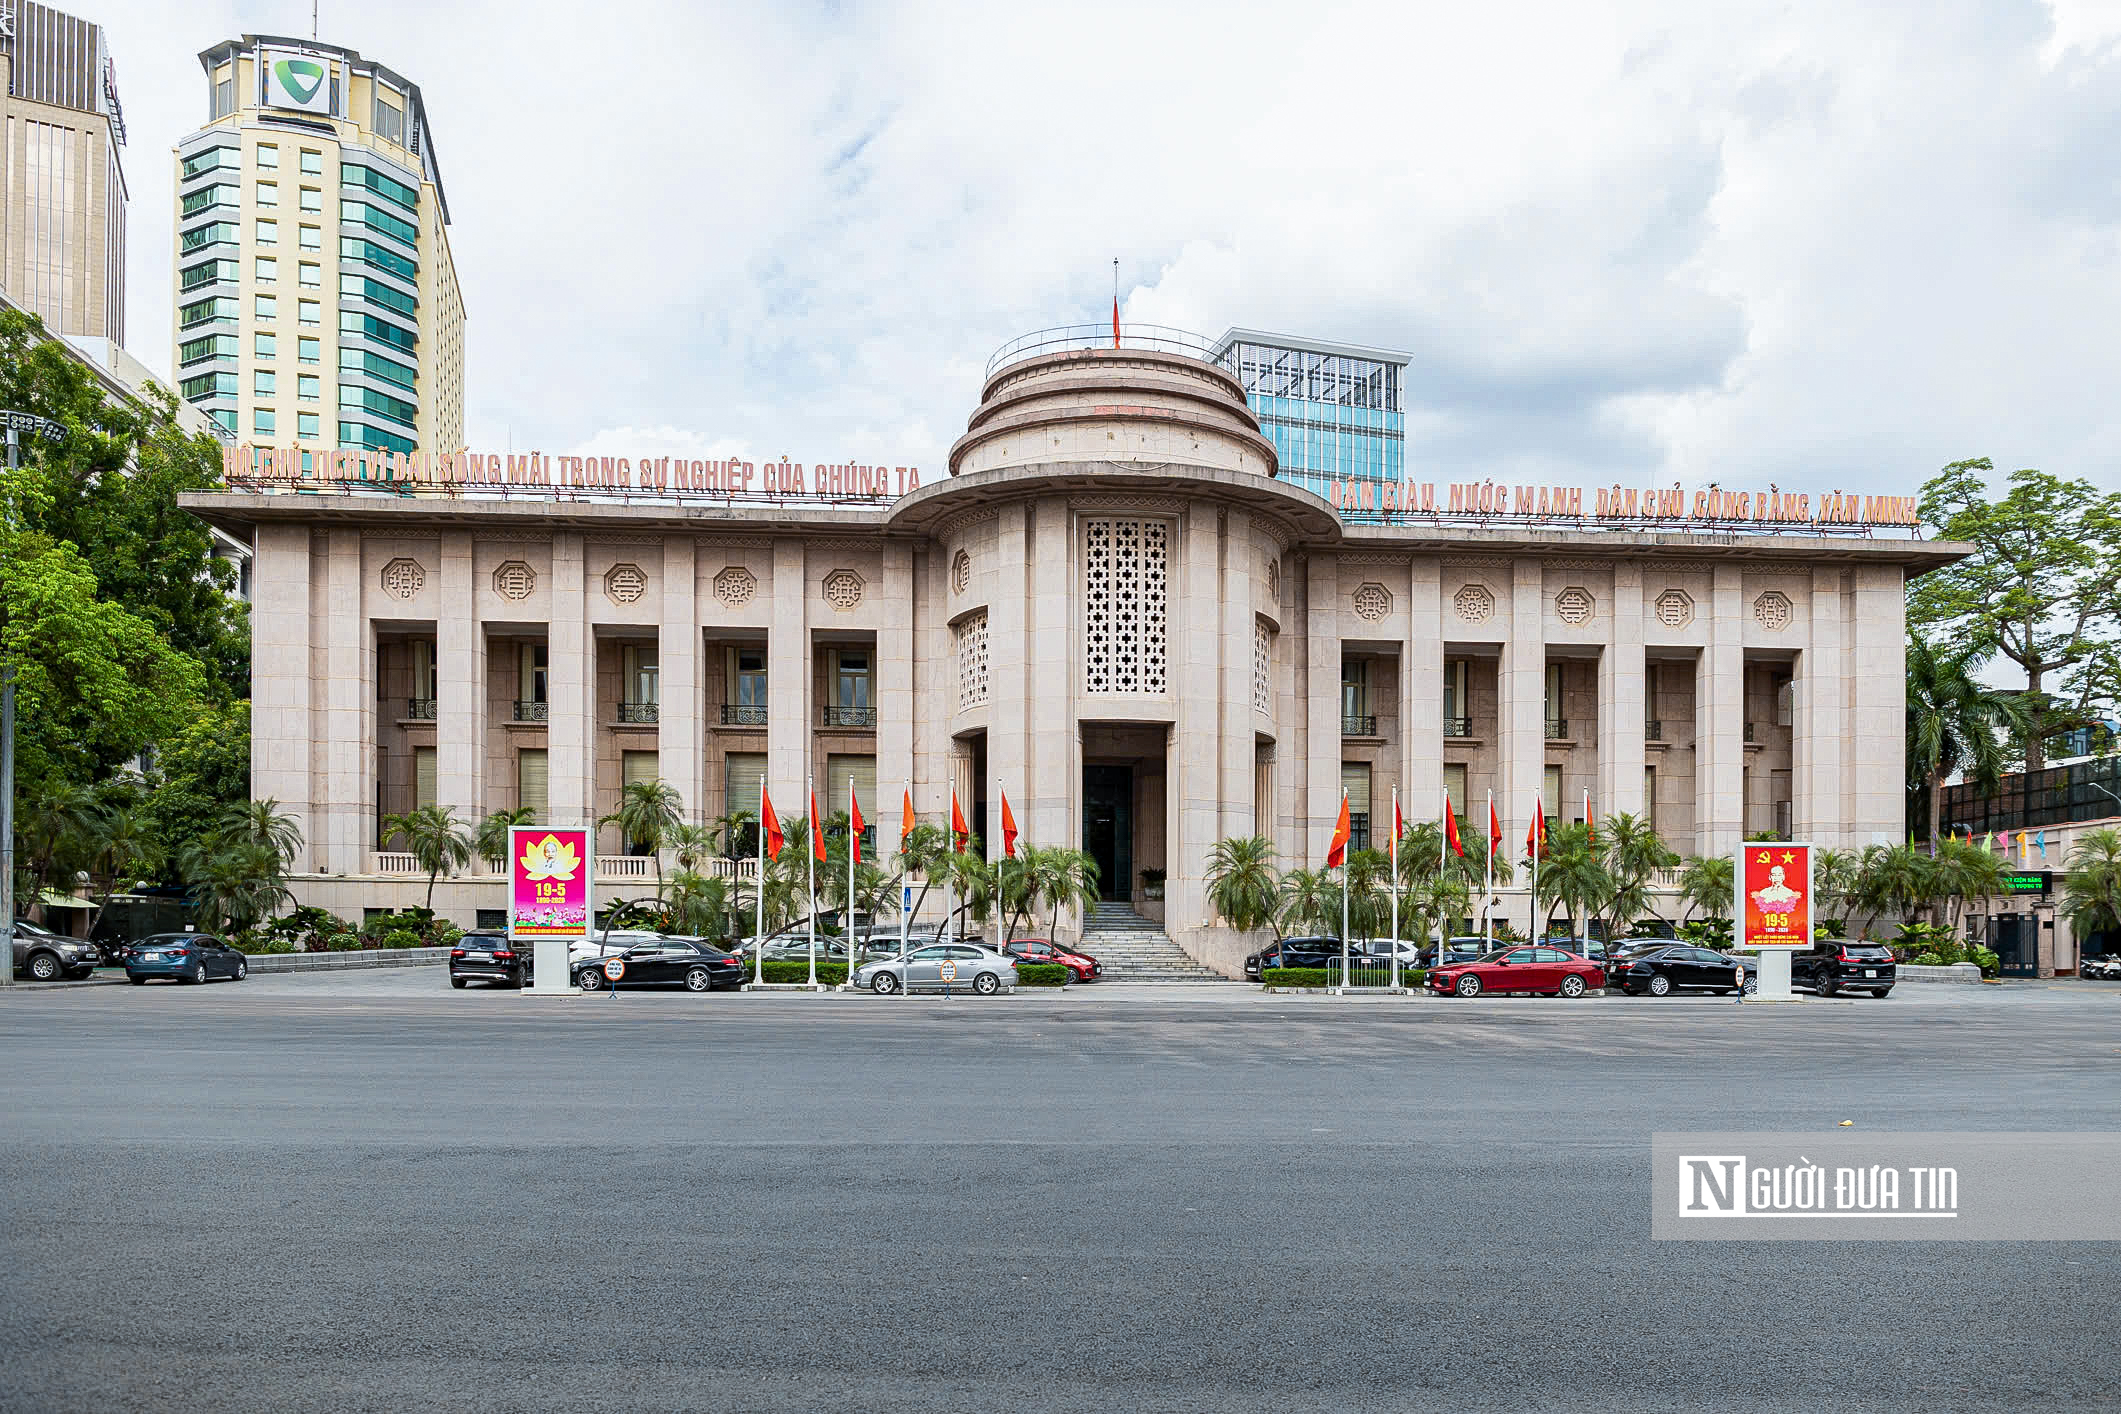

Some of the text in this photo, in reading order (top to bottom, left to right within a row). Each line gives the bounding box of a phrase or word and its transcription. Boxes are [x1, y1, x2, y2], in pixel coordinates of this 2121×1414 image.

[223, 441, 253, 478] HỒ
[261, 441, 302, 479] CHỦ
[310, 447, 358, 485] TỊCH
[365, 445, 388, 481] VĨ
[439, 446, 500, 483] SỐNG
[507, 451, 550, 485] MÃI
[558, 456, 631, 487] TRONG
[640, 456, 669, 493] SỰ
[675, 457, 754, 497] NGHIỆP
[763, 456, 805, 495] CỦA
[815, 460, 889, 495] CHÚNG
[895, 466, 920, 496] TA
[1330, 475, 1374, 510] DÂN
[1449, 478, 1508, 513] NƯỚC
[1597, 484, 1638, 517] DÂN
[1694, 483, 1750, 521] CÔNG
[1820, 489, 1860, 523] VĂN
[535, 883, 566, 896] 19-5
[1764, 913, 1788, 927] 19-5
